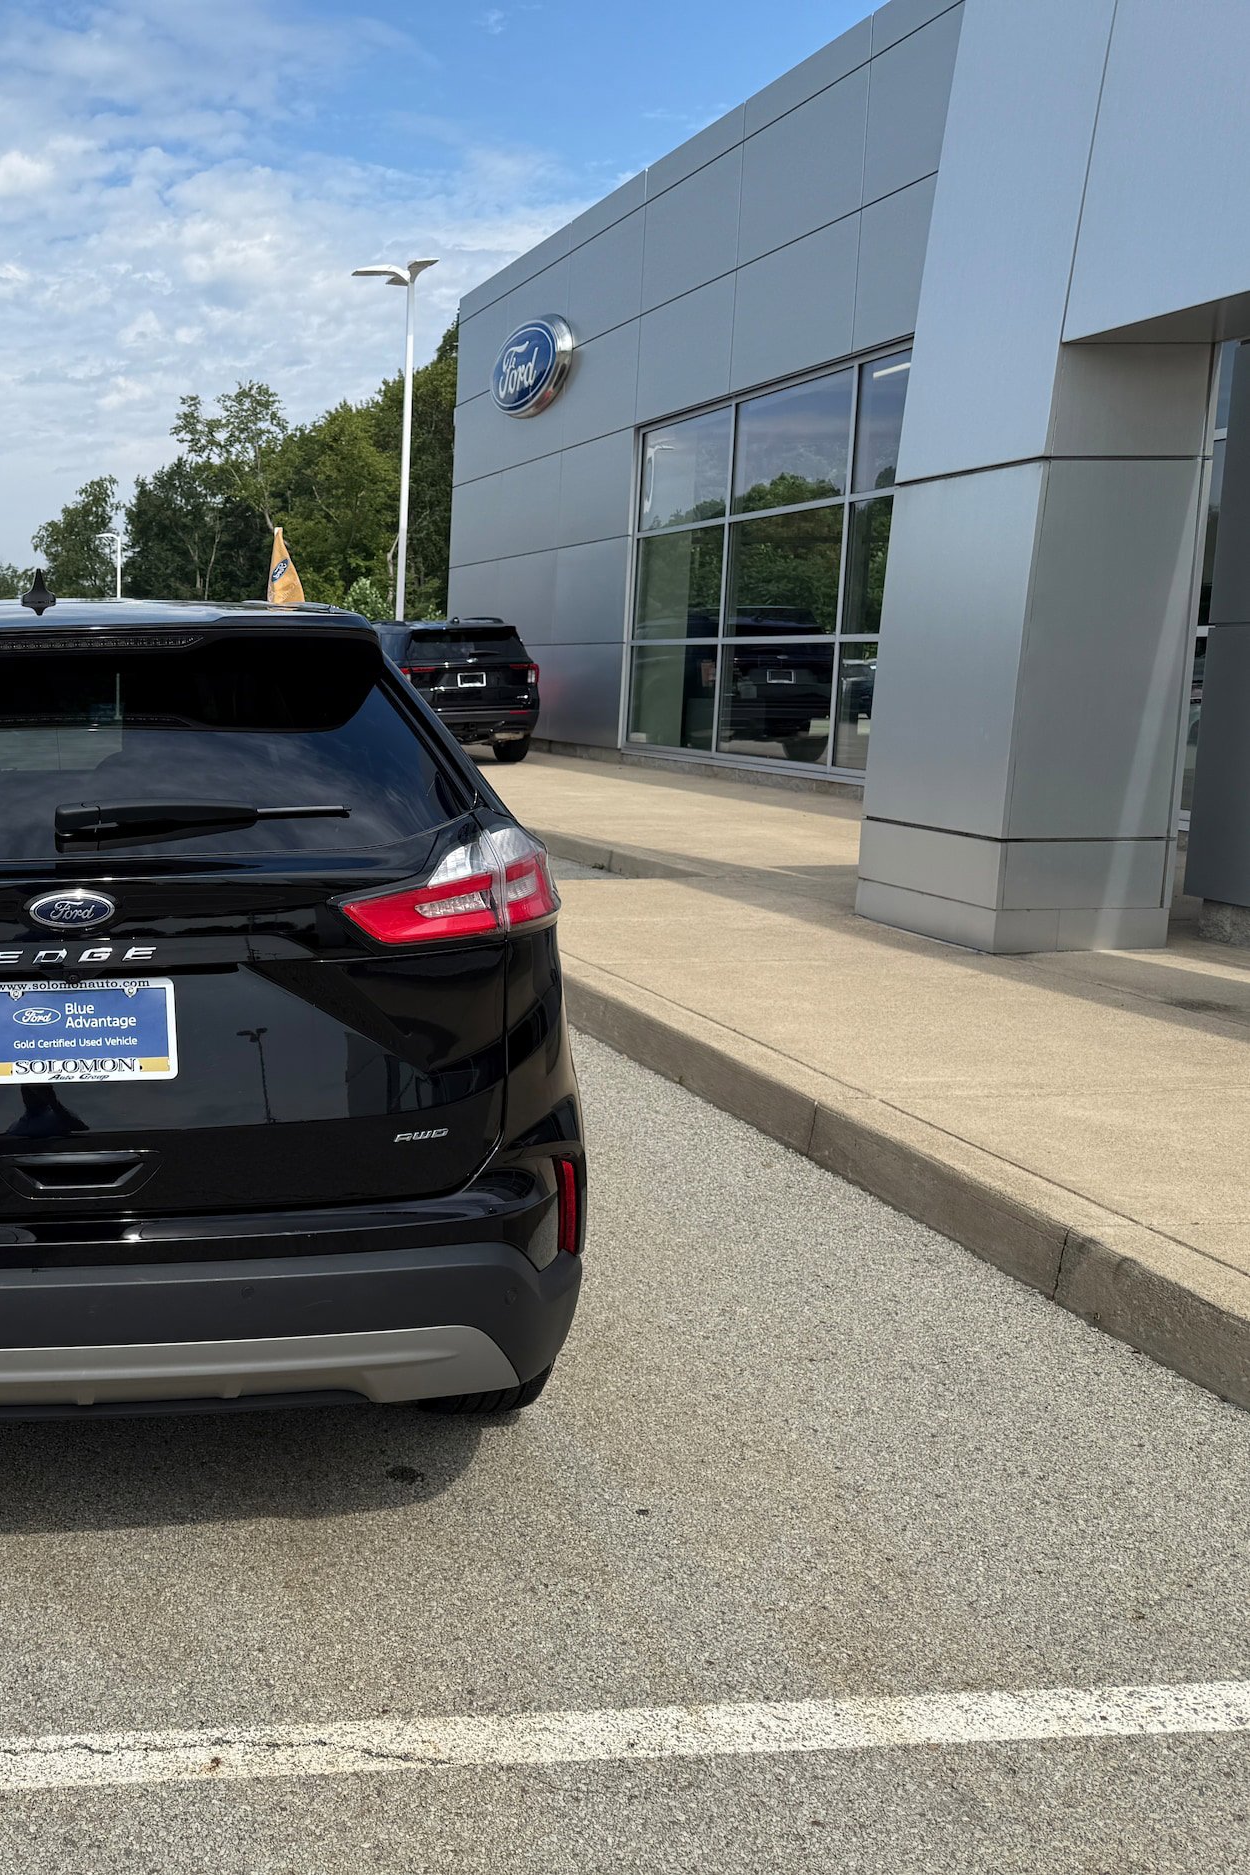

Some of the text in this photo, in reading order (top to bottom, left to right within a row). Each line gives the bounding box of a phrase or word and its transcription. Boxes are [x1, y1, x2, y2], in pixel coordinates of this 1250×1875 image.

[498, 340, 539, 399] Ford
[50, 900, 96, 920] Ford
[64, 1002, 95, 1015] Blue
[65, 1015, 137, 1029] Advantage
[13, 1036, 138, 1049] Gold Certified Used Vehicle
[15, 1058, 136, 1075] SOLOMON
[48, 1072, 110, 1081] Auto Group
[393, 1127, 449, 1143] AWD
